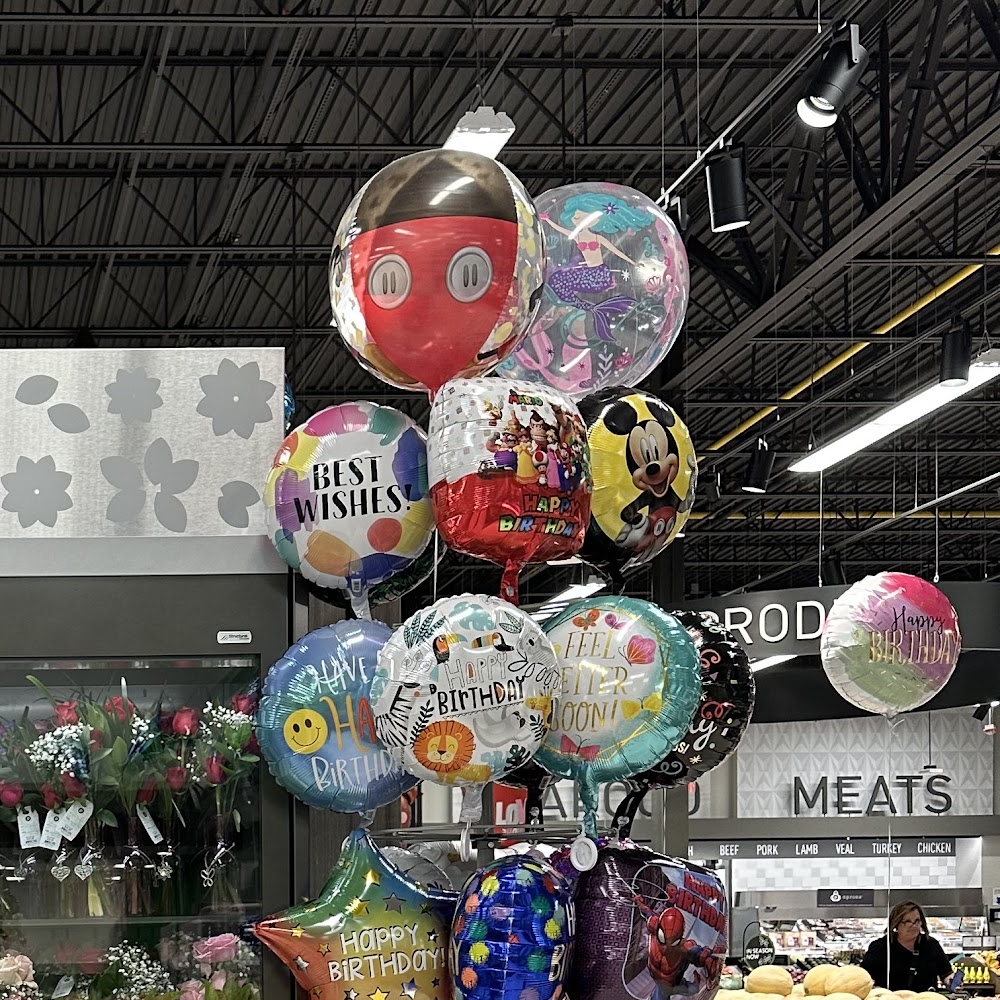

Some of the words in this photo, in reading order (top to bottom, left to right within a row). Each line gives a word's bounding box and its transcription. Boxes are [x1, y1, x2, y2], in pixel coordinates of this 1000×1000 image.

[508, 393, 544, 406] MARIO
[313, 455, 382, 491] BEST
[293, 483, 413, 524] WISHES!
[523, 493, 581, 518] HAPPY
[890, 605, 946, 635] Happy
[564, 629, 616, 660] FEEL
[868, 629, 961, 665] BIRTHDAY
[312, 656, 371, 695] HAVE
[445, 652, 508, 689] HAPPY
[560, 665, 628, 696] ETTER
[794, 775, 952, 815] MEATS
[719, 845, 739, 856] BEEF
[756, 844, 778, 856] PORK
[795, 843, 818, 855] LAMB
[836, 843, 855, 855] VEAL
[872, 843, 902, 855] TURKEY
[917, 842, 952, 854] CHICKEN
[667, 883, 726, 934] BIRTHDA
